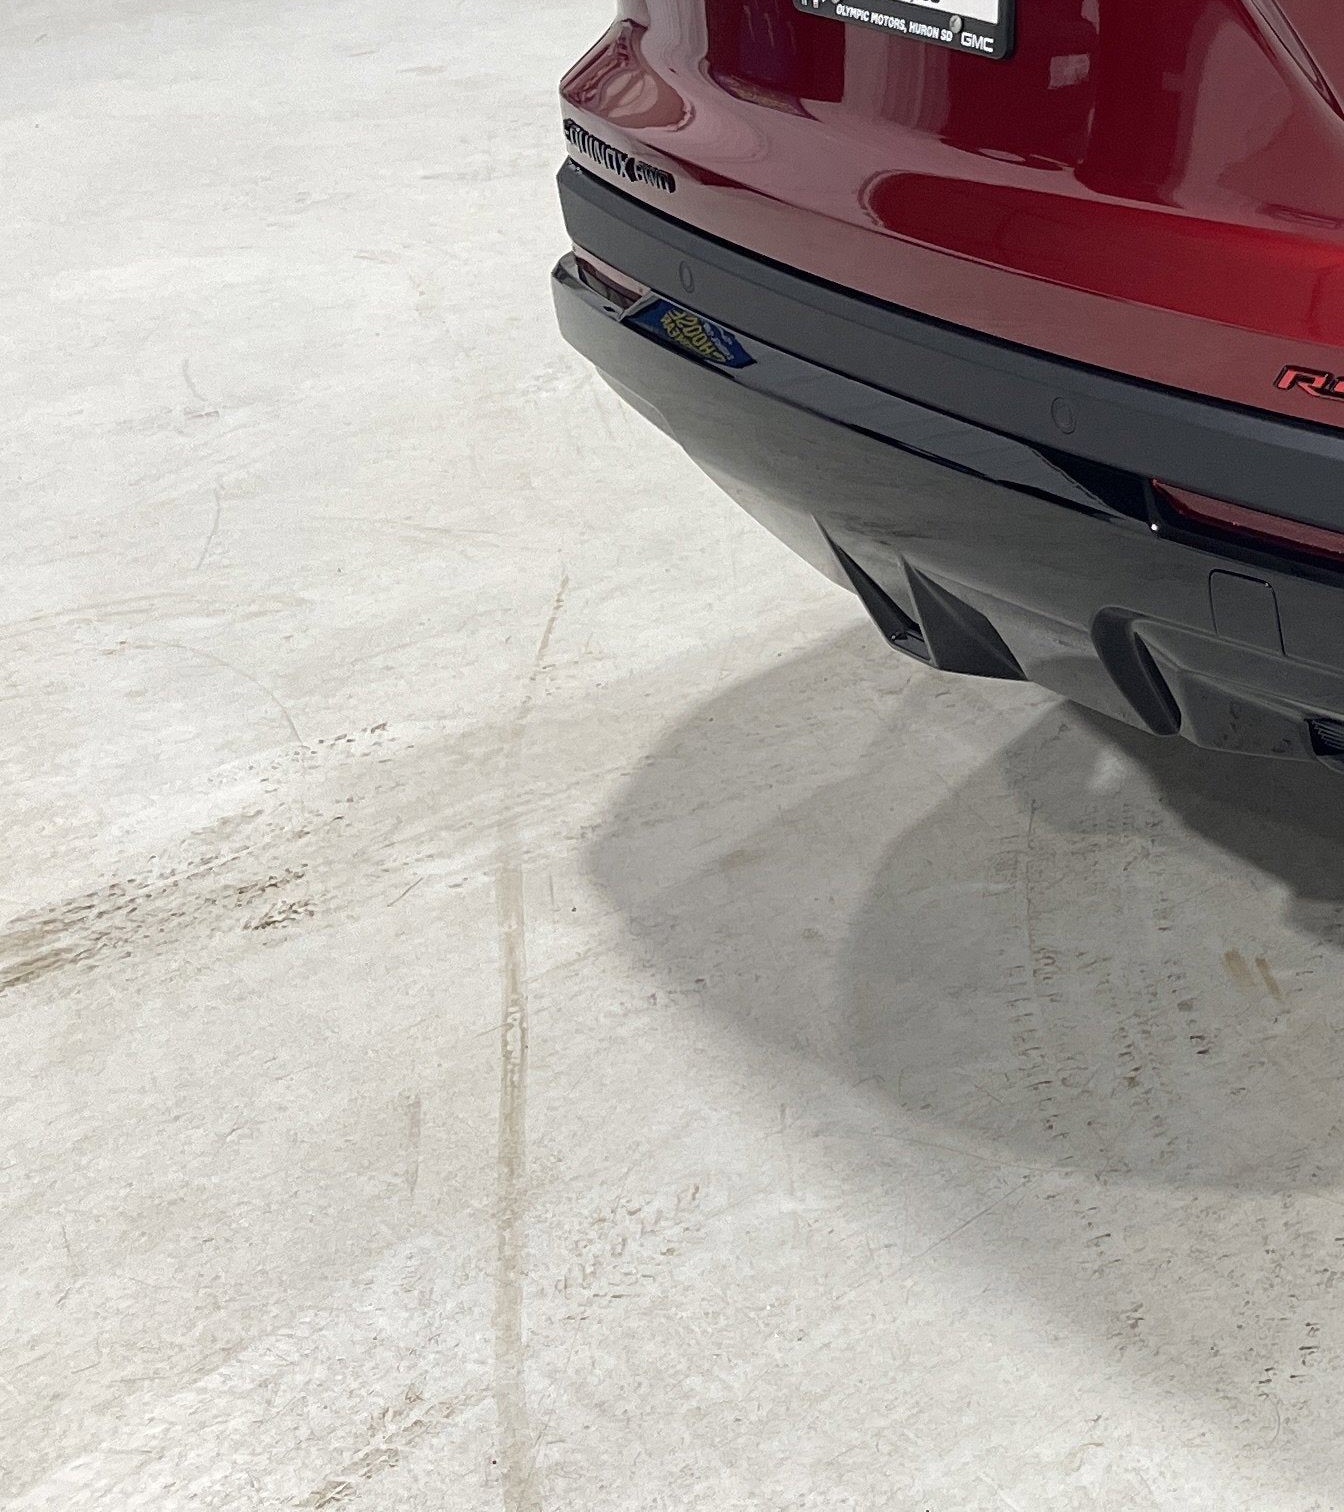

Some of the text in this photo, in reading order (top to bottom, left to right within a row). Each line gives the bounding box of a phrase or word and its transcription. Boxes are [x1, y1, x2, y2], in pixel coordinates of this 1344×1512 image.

[836, 4, 953, 42] OLYMPIC MOTORS, HURON SD
[961, 32, 994, 53] GMC
